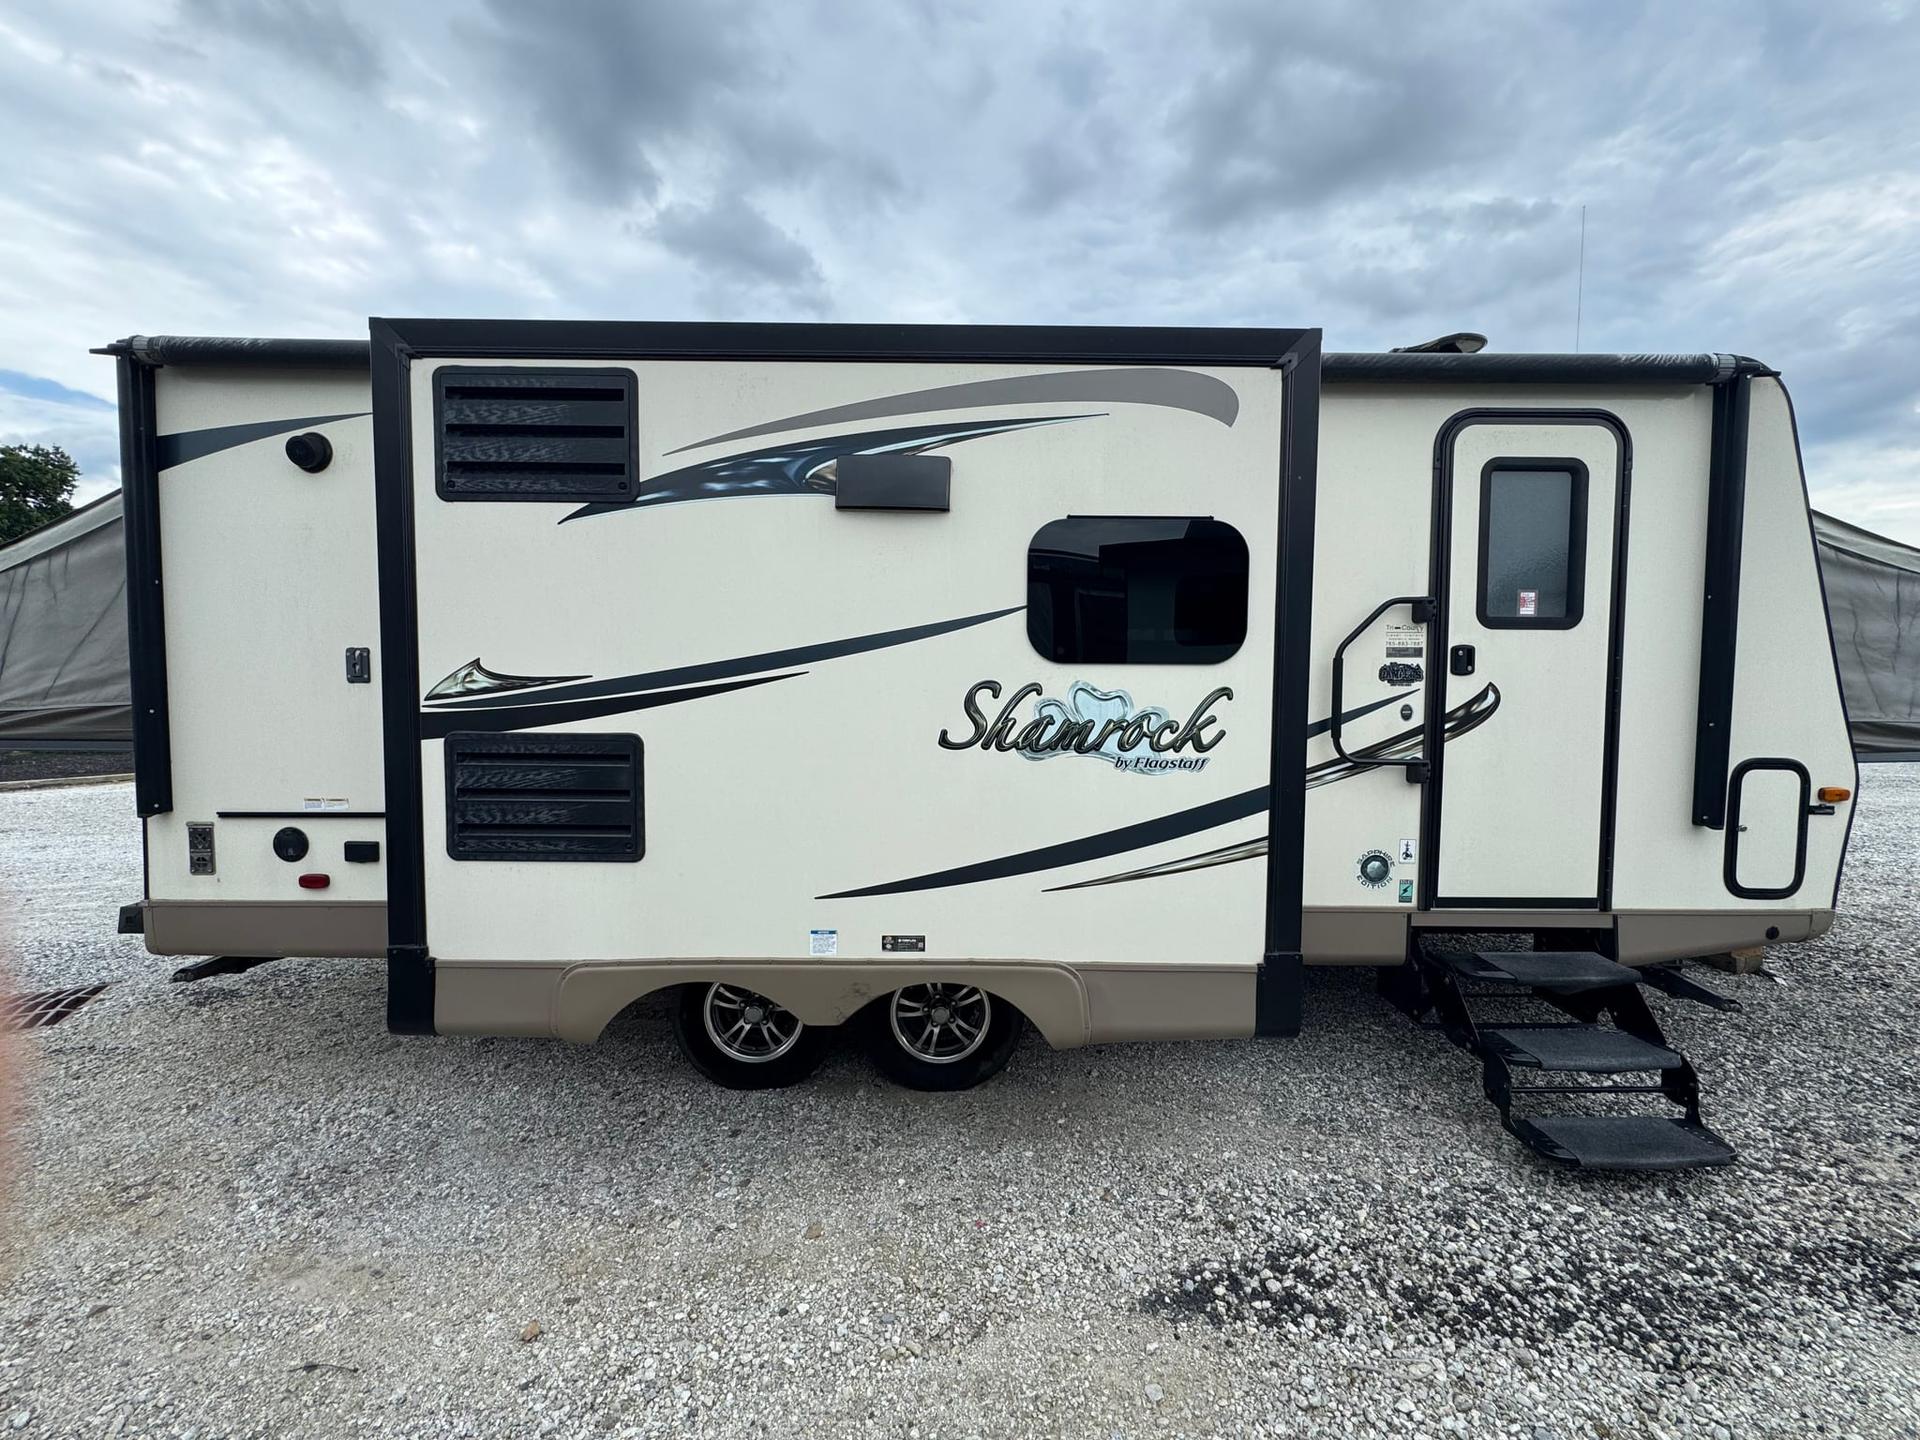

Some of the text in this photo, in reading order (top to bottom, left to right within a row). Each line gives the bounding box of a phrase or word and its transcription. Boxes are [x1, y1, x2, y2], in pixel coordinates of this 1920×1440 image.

[938, 679, 1235, 754] Shamrock
[1114, 757, 1210, 771] by Flagstaff
[1356, 874, 1393, 889] EDITION
